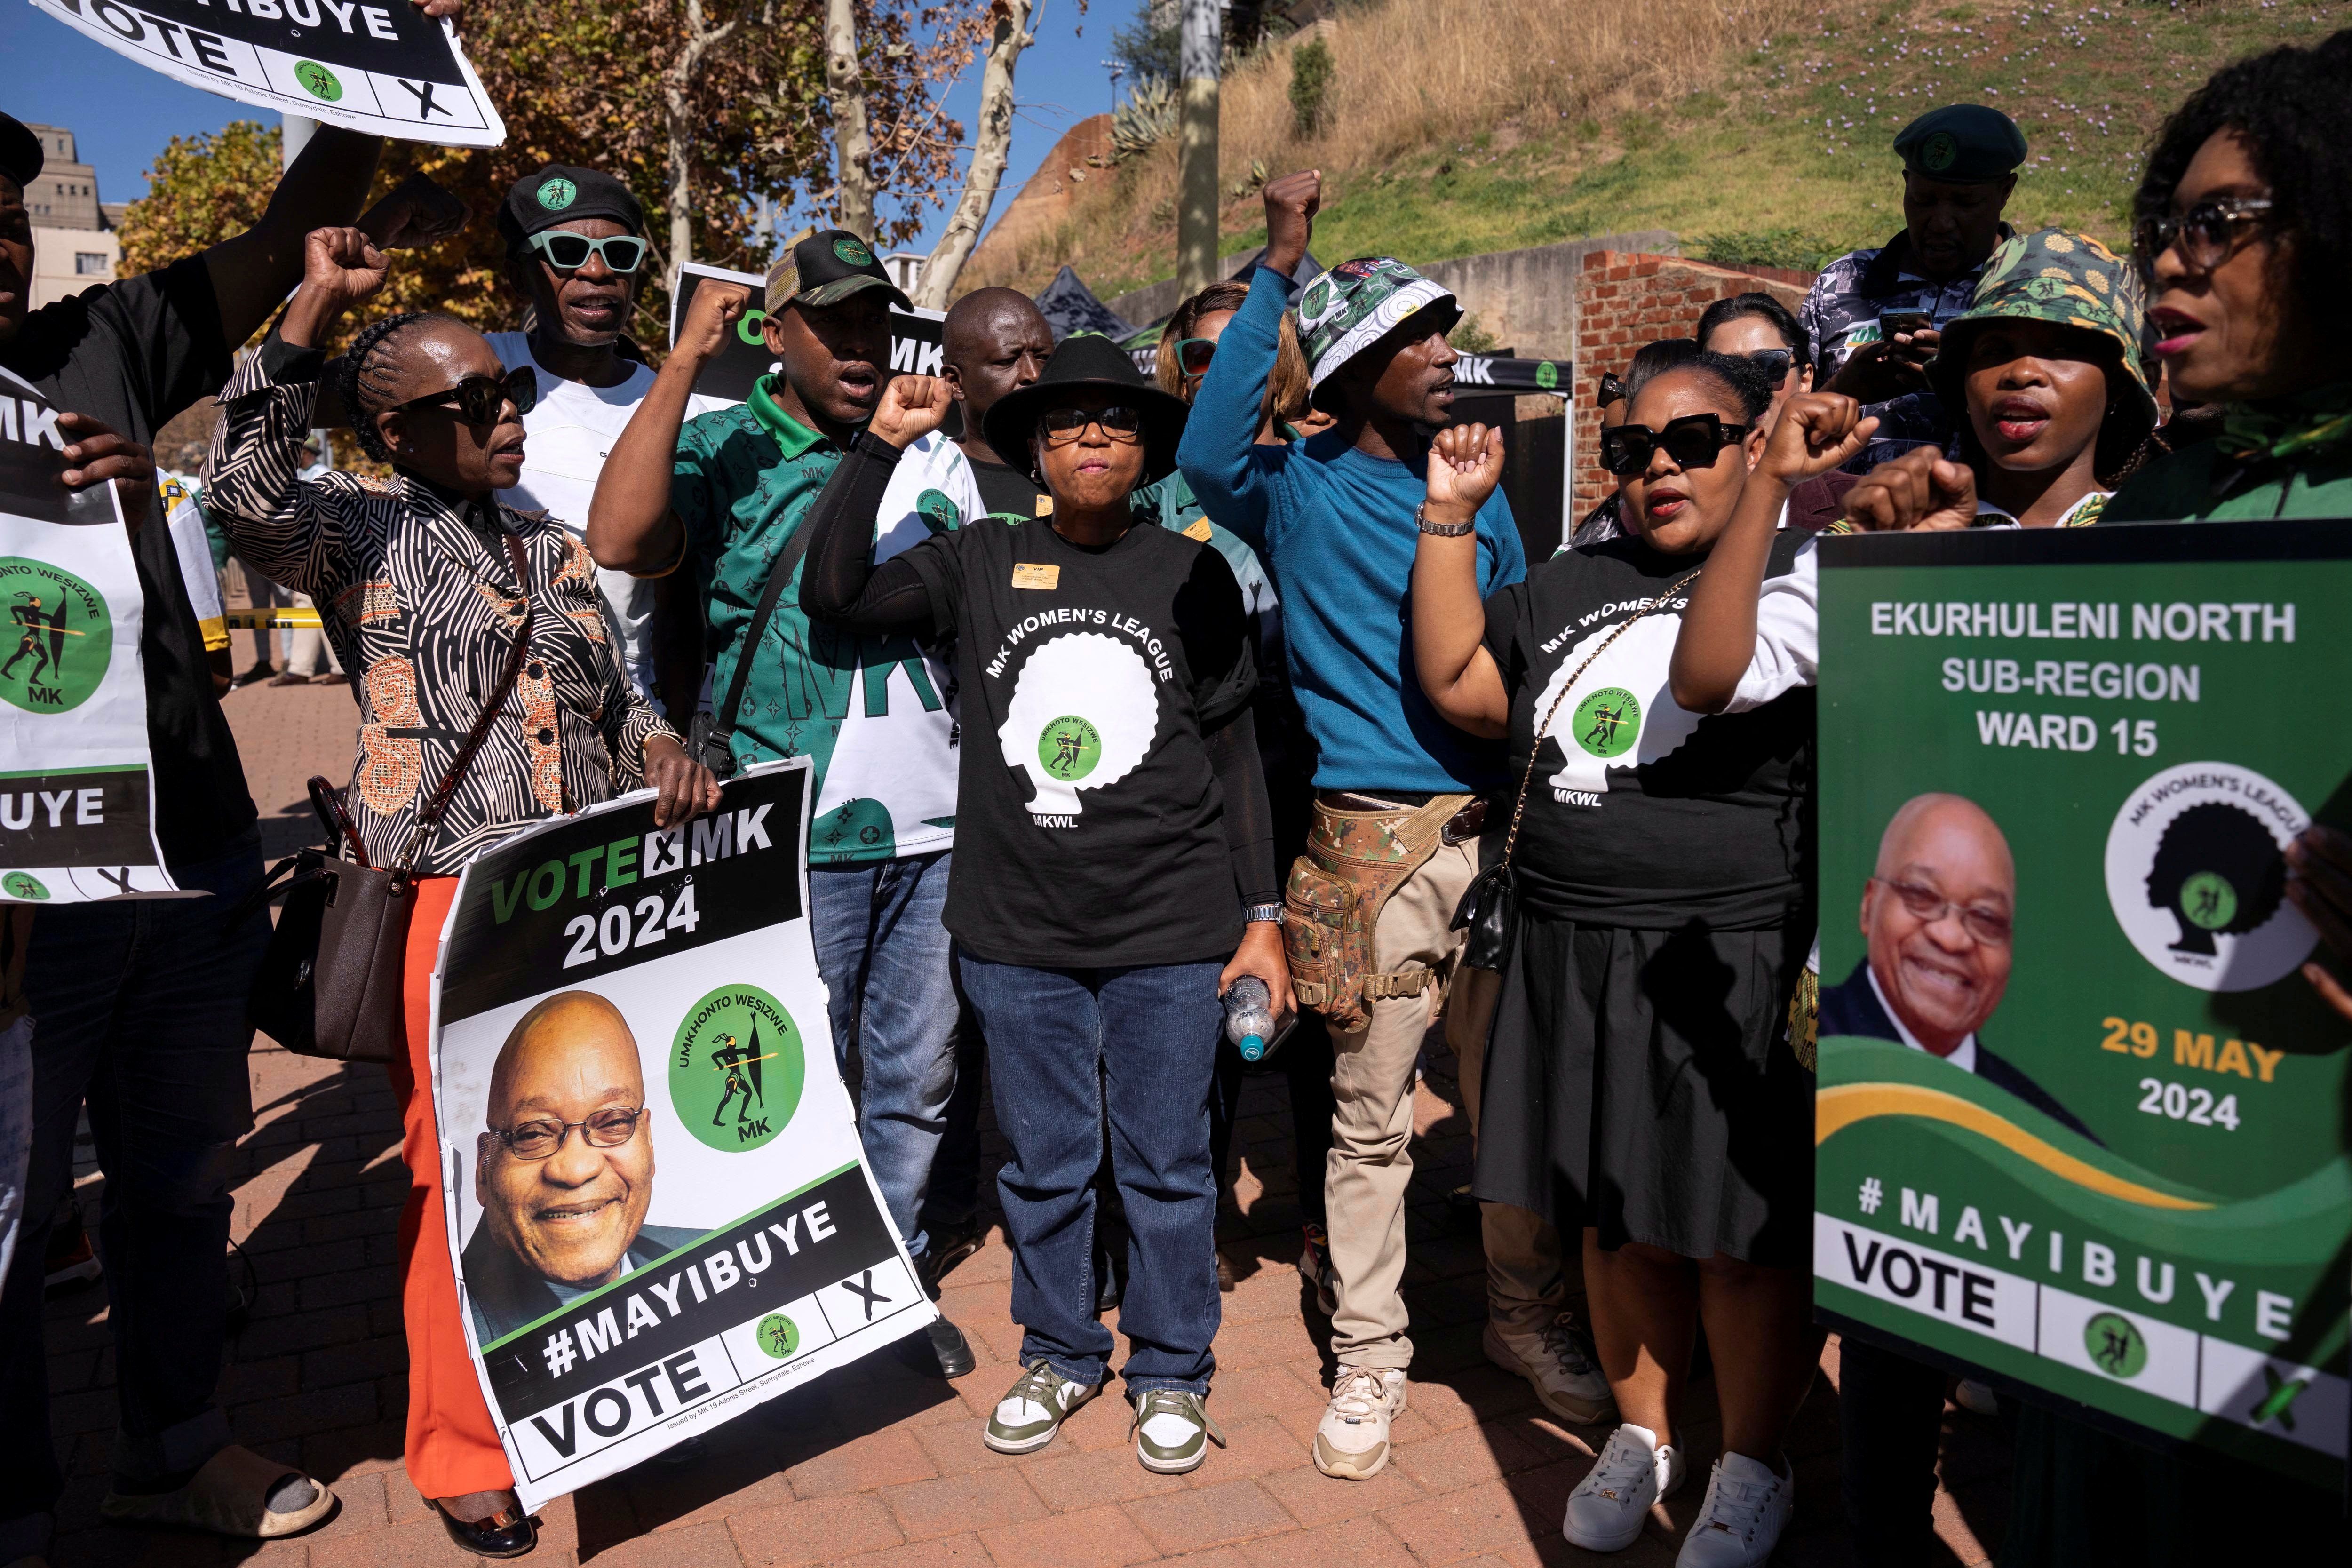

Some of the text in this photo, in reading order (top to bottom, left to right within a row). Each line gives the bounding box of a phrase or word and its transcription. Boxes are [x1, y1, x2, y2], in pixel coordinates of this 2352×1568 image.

[186, 68, 210, 81] Issued
[210, 75, 219, 84] by
[221, 80, 234, 88] MK
[244, 87, 267, 98] Adonis
[268, 94, 291, 105] Street,
[292, 100, 329, 115] Sunnydale,
[330, 109, 356, 120] Eshowe
[315, 64, 336, 81] WESIZWE
[1335, 307, 1348, 320] MK
[802, 466, 825, 479] MK
[37, 568, 100, 619] WESIZWE
[986, 608, 1173, 683] MK WOMEN'S LEAGUE
[1540, 597, 1689, 653] MK WOMEN'S
[1871, 602, 2296, 643] EKURHULENI NORTH
[28, 686, 64, 705] MK
[1616, 690, 1638, 718] WESIZWE
[1941, 658, 2200, 703] SUB-REGION
[1073, 717, 1098, 744] WESIZWE
[1975, 710, 2159, 756] WARD 15
[1033, 814, 1078, 828] MKWL
[1554, 788, 1602, 807] MKWL
[2129, 799, 2154, 826] MK
[2151, 773, 2240, 804] WOMEN'S
[492, 836, 639, 925] VOTE
[691, 803, 775, 868] MK
[563, 884, 699, 970] 2024
[679, 994, 788, 1068] UMKHONTO WESIZWE
[2100, 1016, 2286, 1083] 29 MAY
[2137, 1077, 2240, 1130] 2024
[737, 1116, 772, 1143] MK
[543, 1200, 838, 1379] #MAYIBUYE
[1843, 1230, 1995, 1329] VOTE
[773, 1316, 792, 1326] WESIZWE
[781, 1347, 792, 1356] MK
[530, 1349, 711, 1459] VOTE
[667, 1358, 815, 1430] Issued by MK 19 Adonis Street, Sunnydale, Eshowe
